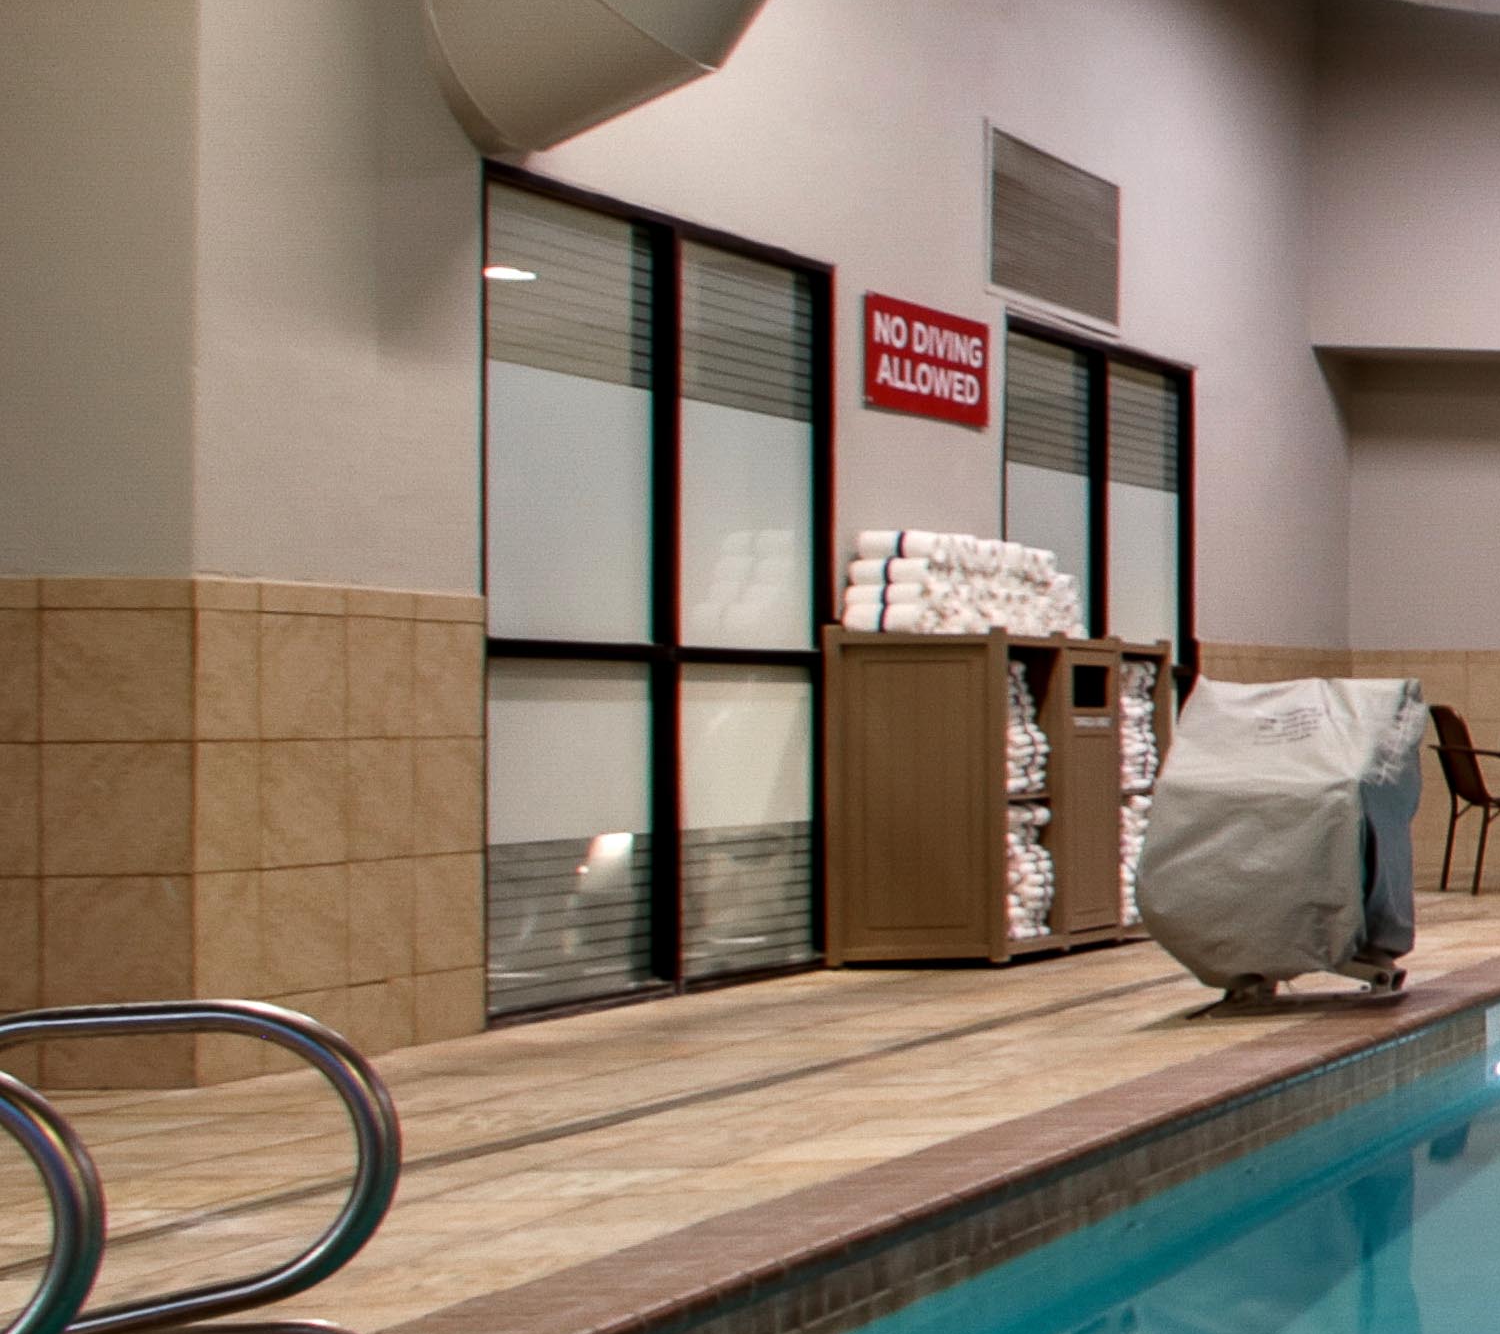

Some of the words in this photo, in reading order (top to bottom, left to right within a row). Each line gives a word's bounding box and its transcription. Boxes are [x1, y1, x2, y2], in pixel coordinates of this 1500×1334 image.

[873, 310, 908, 349] NO
[912, 320, 983, 368] DIVING
[876, 353, 981, 405] ALLOWED
